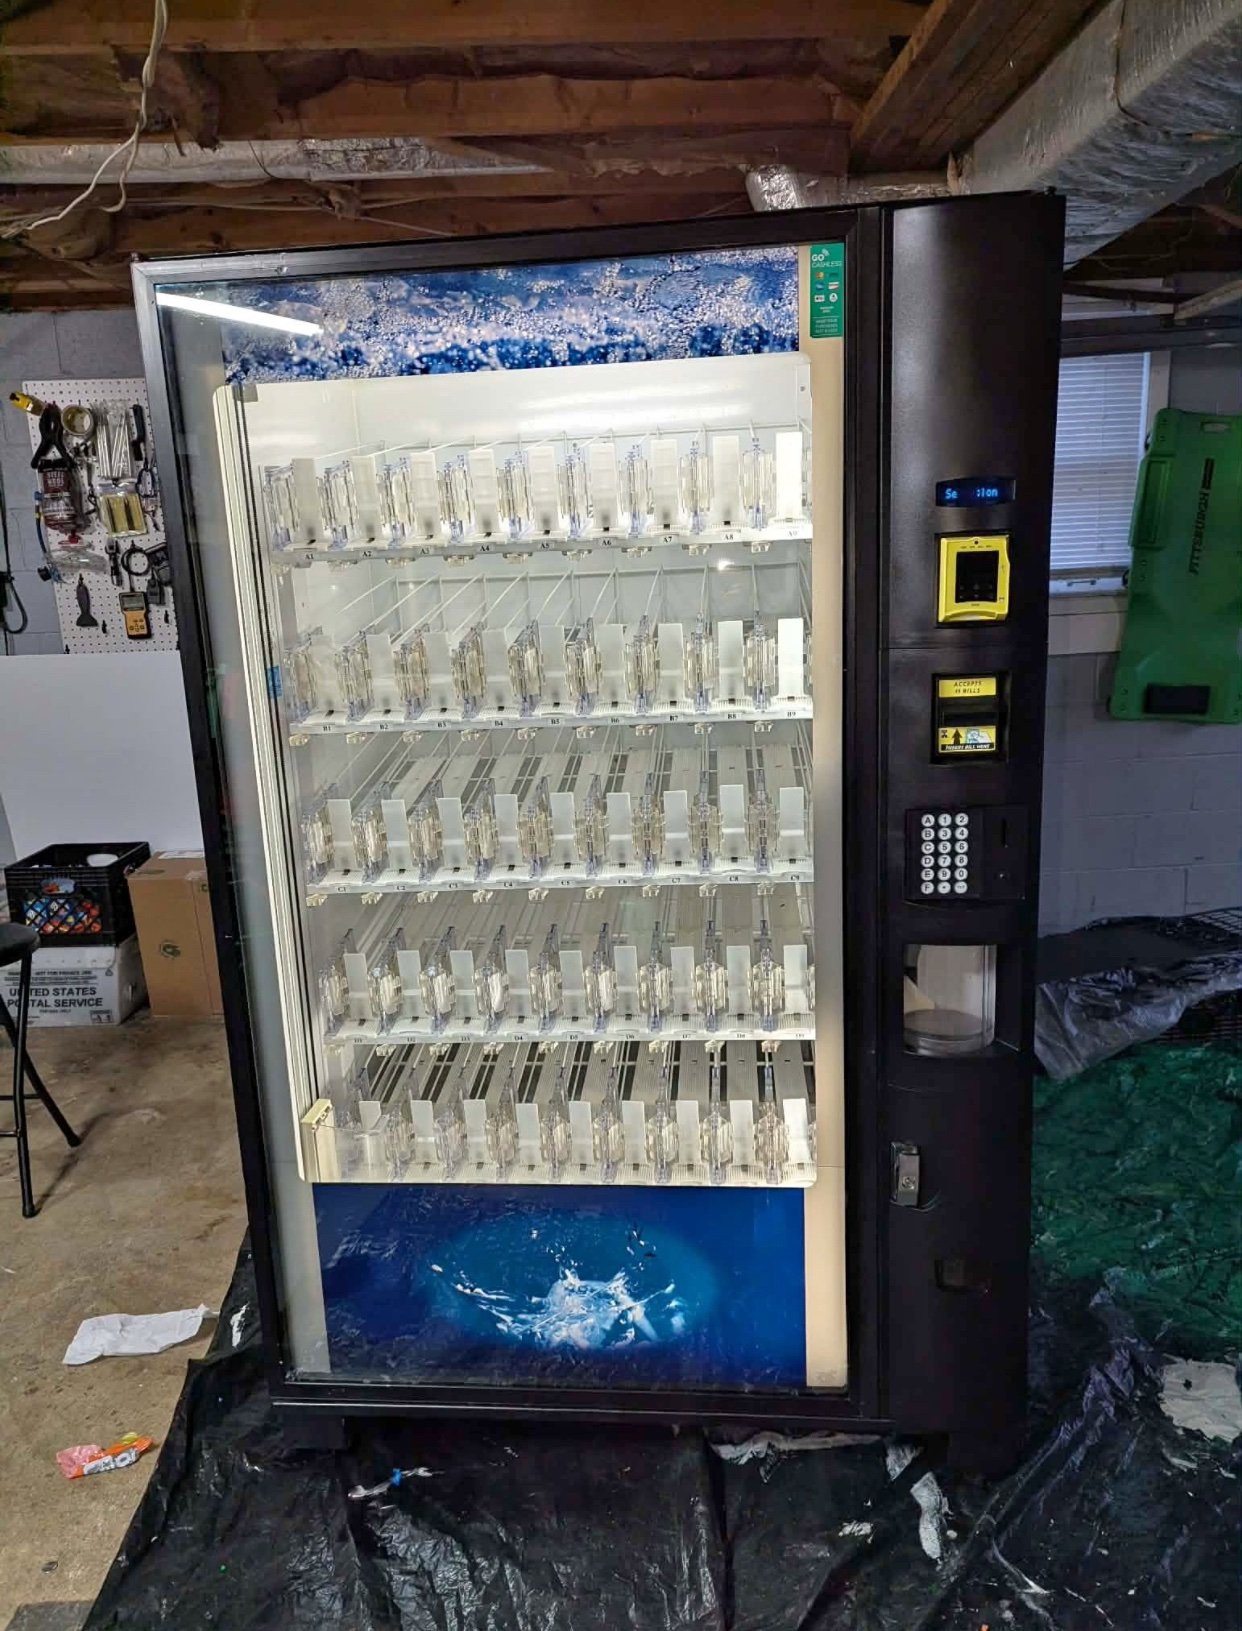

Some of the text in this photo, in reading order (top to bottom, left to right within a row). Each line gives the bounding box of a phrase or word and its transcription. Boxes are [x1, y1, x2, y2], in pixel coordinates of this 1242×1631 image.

[811, 254, 825, 262] GO
[924, 815, 965, 825] A 1 2
[924, 829, 965, 838] B 3 4
[924, 843, 965, 852] C 5 6
[924, 857, 932, 865] D
[942, 857, 948, 865] 7
[924, 870, 931, 878] E
[958, 869, 964, 878] 0
[924, 884, 931, 892] F
[9, 987, 96, 996] UTED STATES
[7, 998, 103, 1008] POTAL SERVICE
